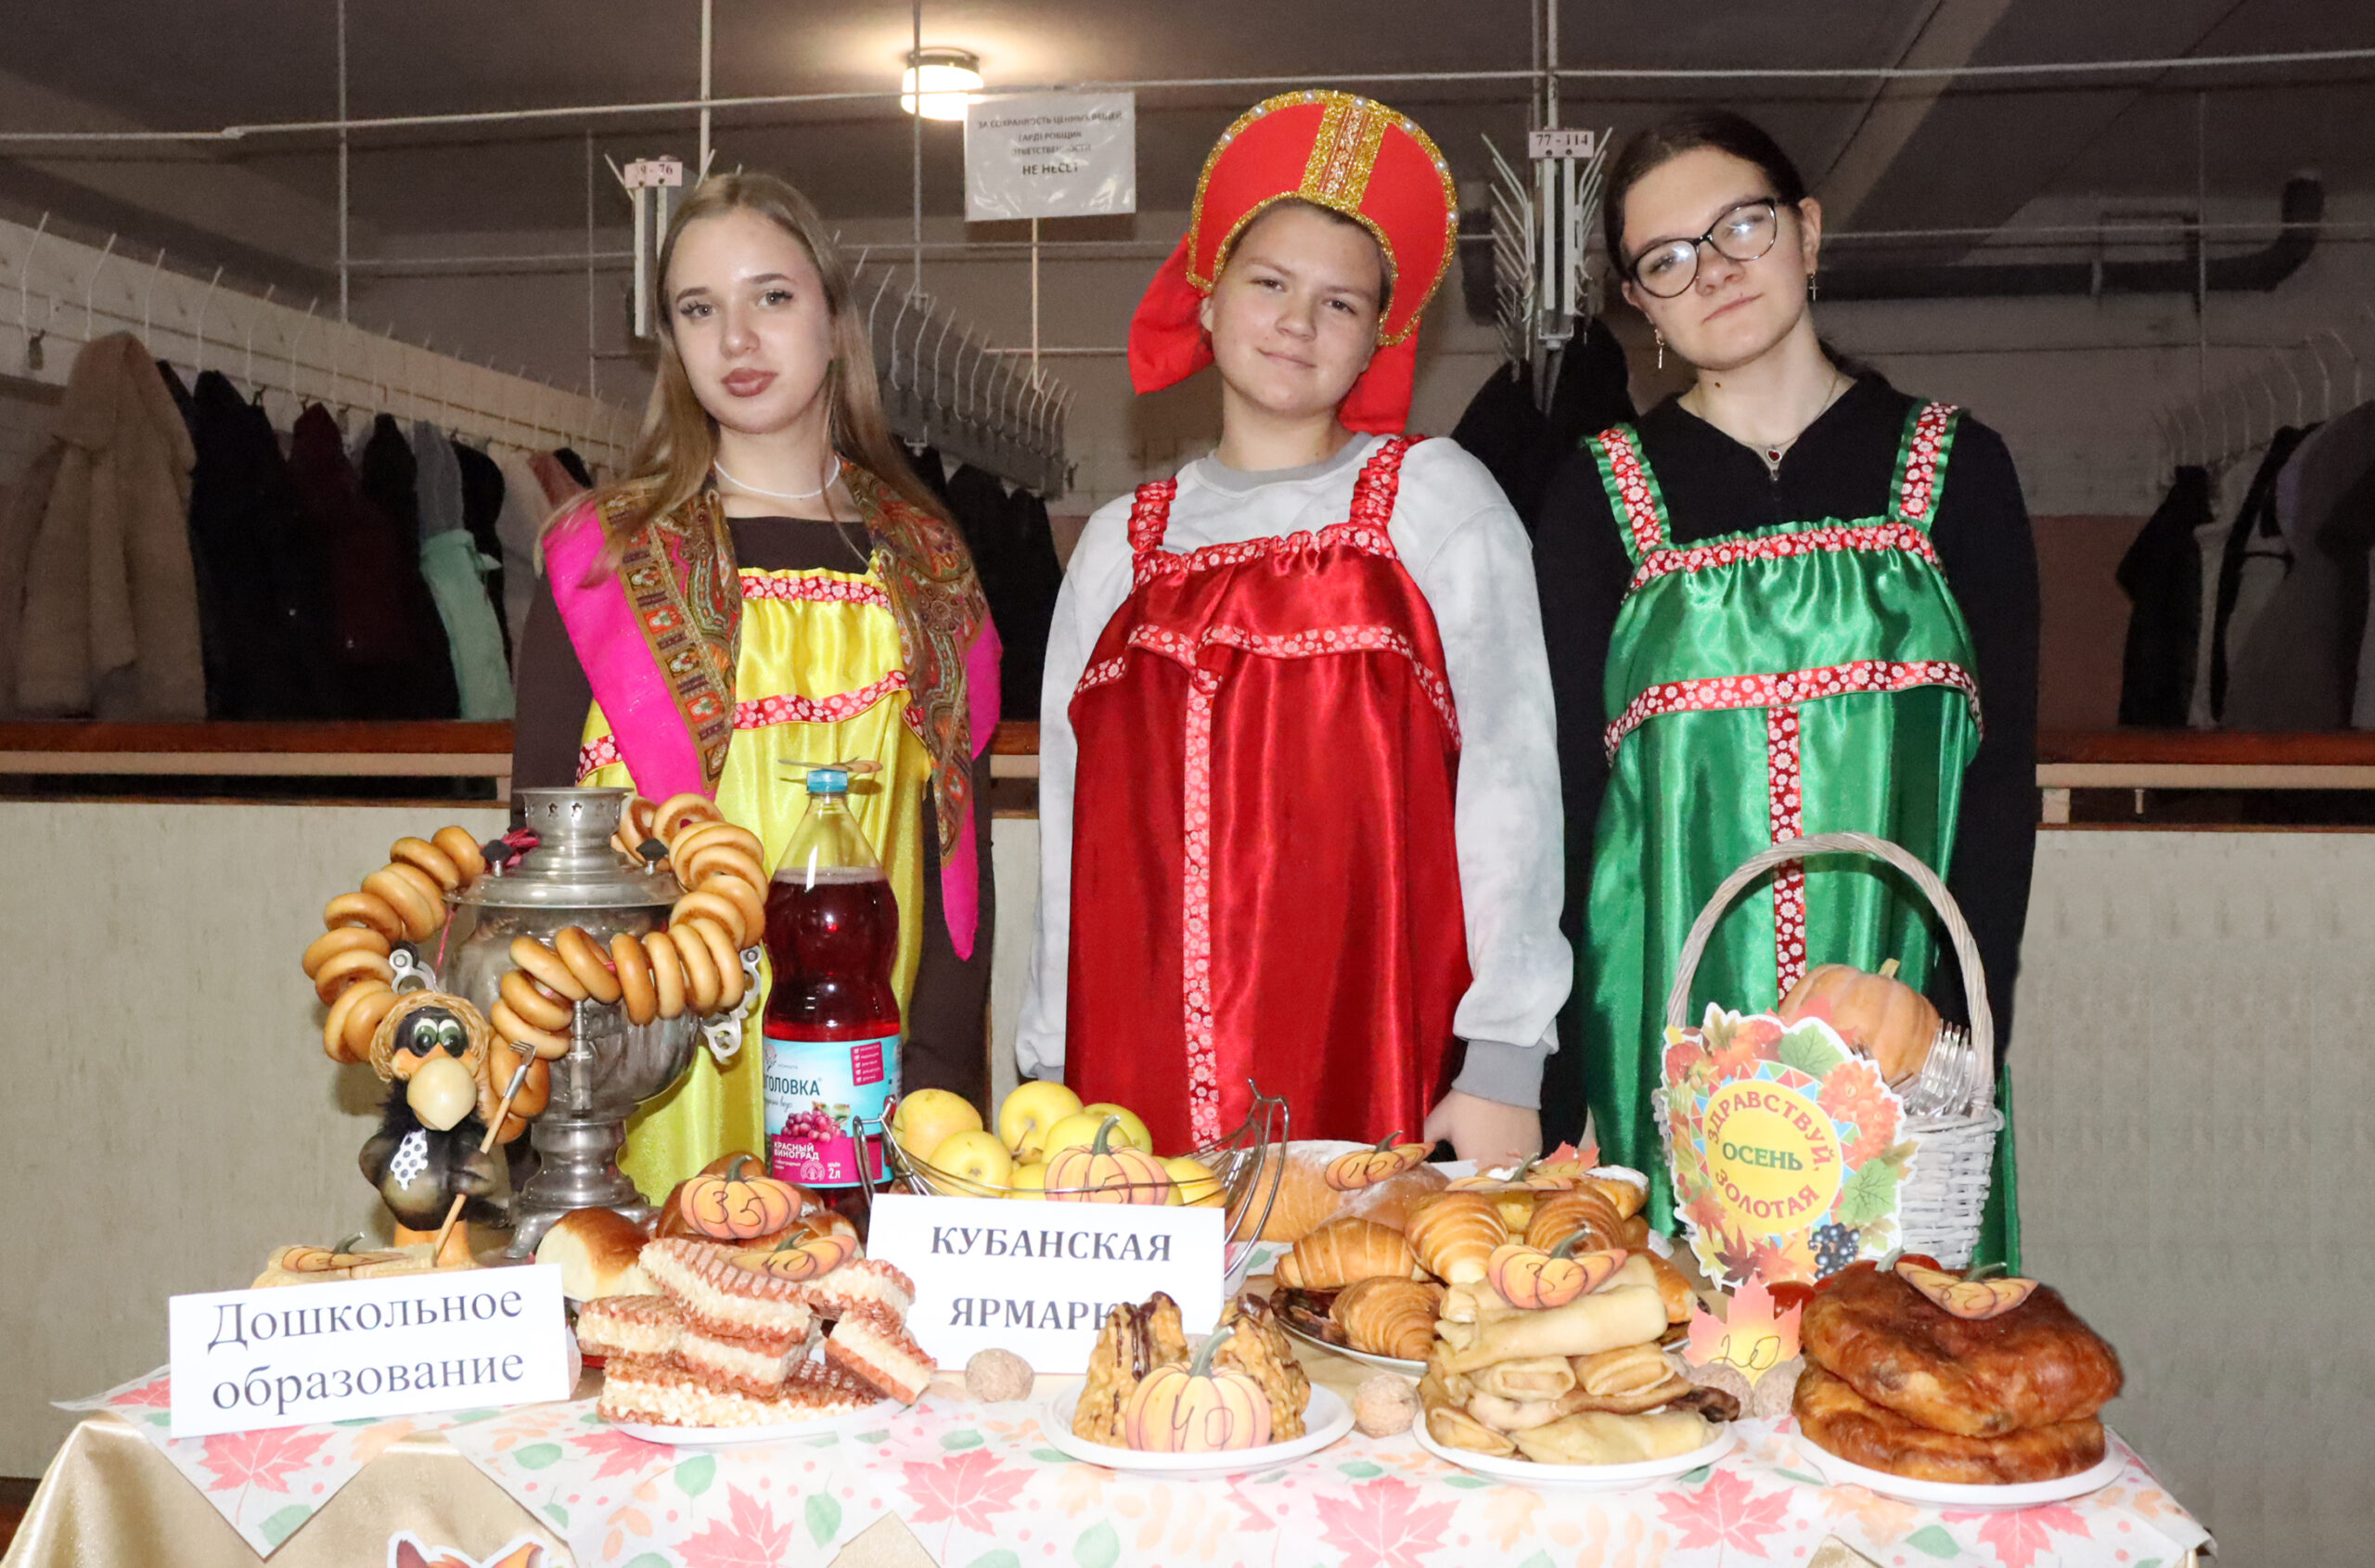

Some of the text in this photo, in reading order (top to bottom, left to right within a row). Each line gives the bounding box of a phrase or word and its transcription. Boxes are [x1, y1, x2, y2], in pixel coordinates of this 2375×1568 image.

[1536, 134, 1551, 146] 77
[1566, 134, 1587, 146] 114
[1022, 163, 1039, 175] НЕ
[774, 1142, 815, 1152] КРАСНЫЙ
[774, 1149, 820, 1161] ВИНОГРАД
[1722, 1142, 1804, 1171] ОСЕНЬ
[703, 1190, 764, 1227] 35
[1715, 1169, 1820, 1219] ЗОЛОТАЯ
[931, 1226, 1173, 1262] КУБАНСКАЯ
[207, 1290, 523, 1355] Дошкольное
[949, 1297, 1120, 1331] ЯРМАРК
[212, 1353, 524, 1416] образование
